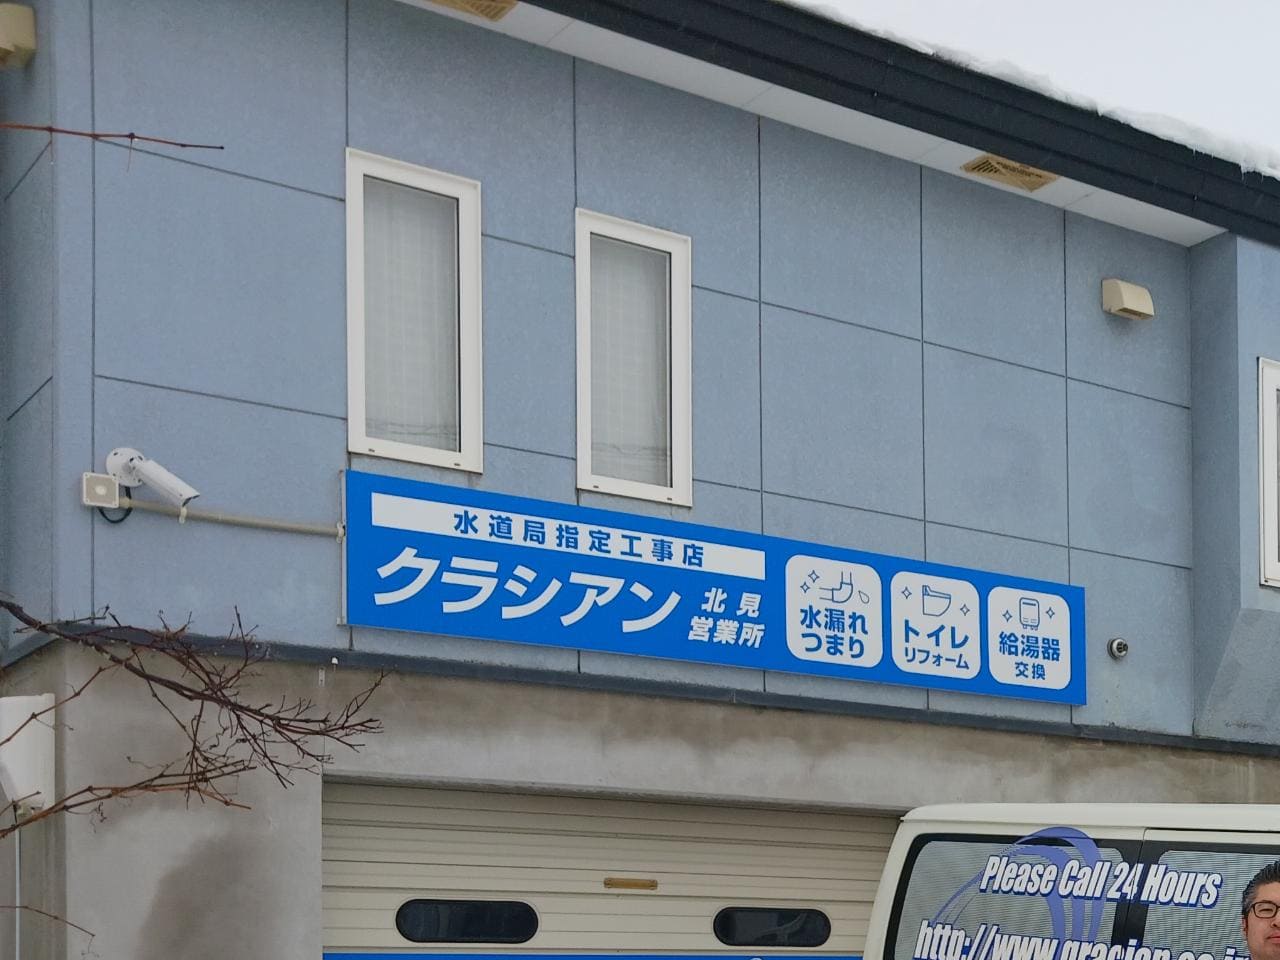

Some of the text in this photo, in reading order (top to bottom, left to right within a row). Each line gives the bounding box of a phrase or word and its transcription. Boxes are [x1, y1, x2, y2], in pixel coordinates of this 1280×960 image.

[453, 510, 704, 567] 水道局指定工事店
[374, 547, 681, 633] クラシアン
[701, 586, 762, 618] 北見
[688, 616, 766, 649] 営業所
[800, 605, 868, 635] 水漏れ
[904, 619, 969, 649] トイレ
[801, 633, 865, 659] つまり
[904, 647, 970, 670] リフォーム
[998, 631, 1061, 662] 給湯器
[1014, 662, 1046, 681] 交換
[979, 855, 1223, 909] Please Call 24 Hours
